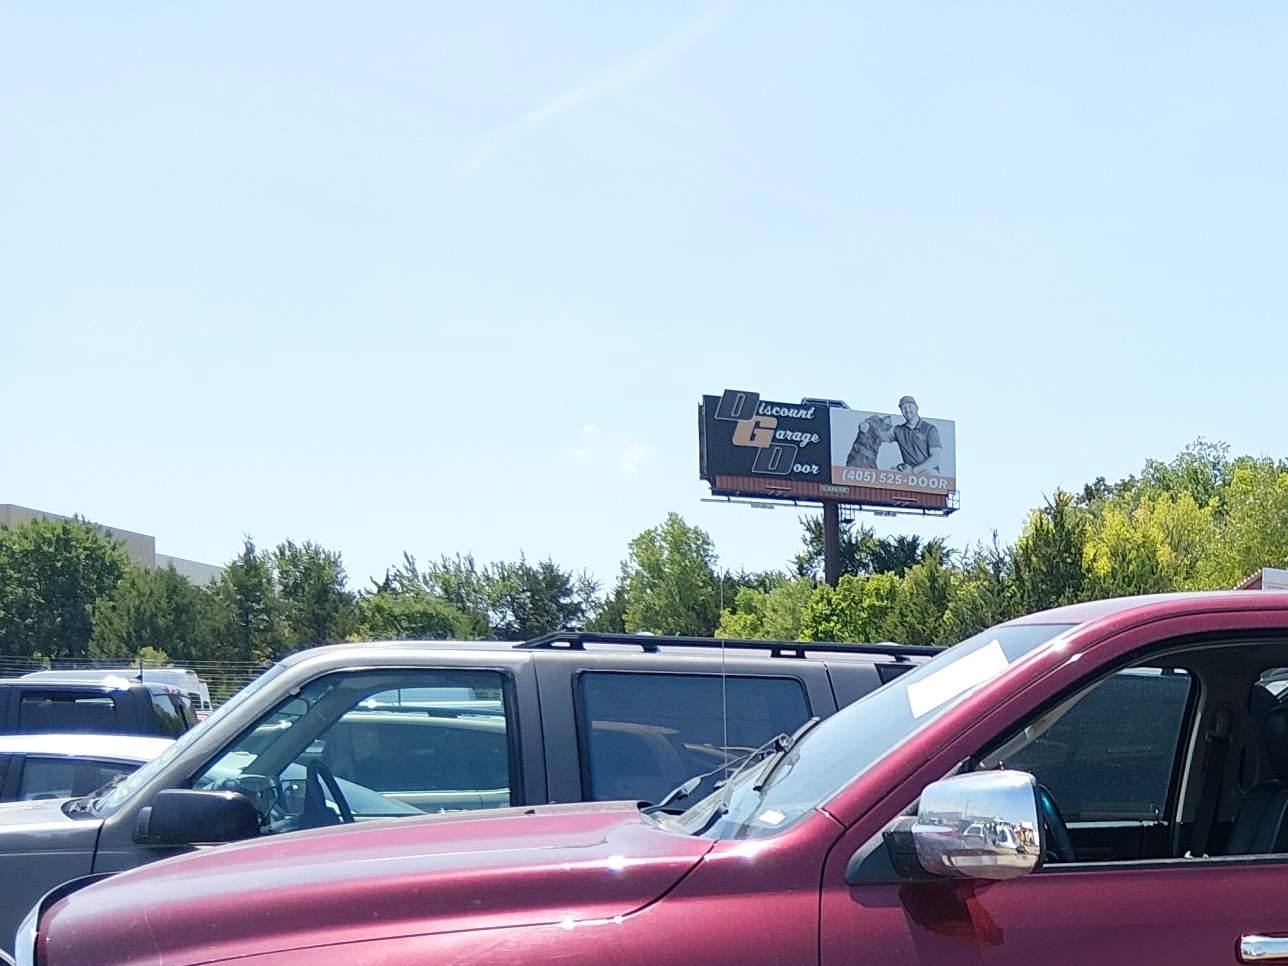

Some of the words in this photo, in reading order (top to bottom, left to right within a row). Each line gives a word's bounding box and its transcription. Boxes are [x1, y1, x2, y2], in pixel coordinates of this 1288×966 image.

[714, 389, 815, 421] Discount
[732, 416, 820, 449] Garage
[752, 442, 819, 475] Door
[842, 469, 876, 484] (405)
[879, 472, 948, 489] 525-DOOR
